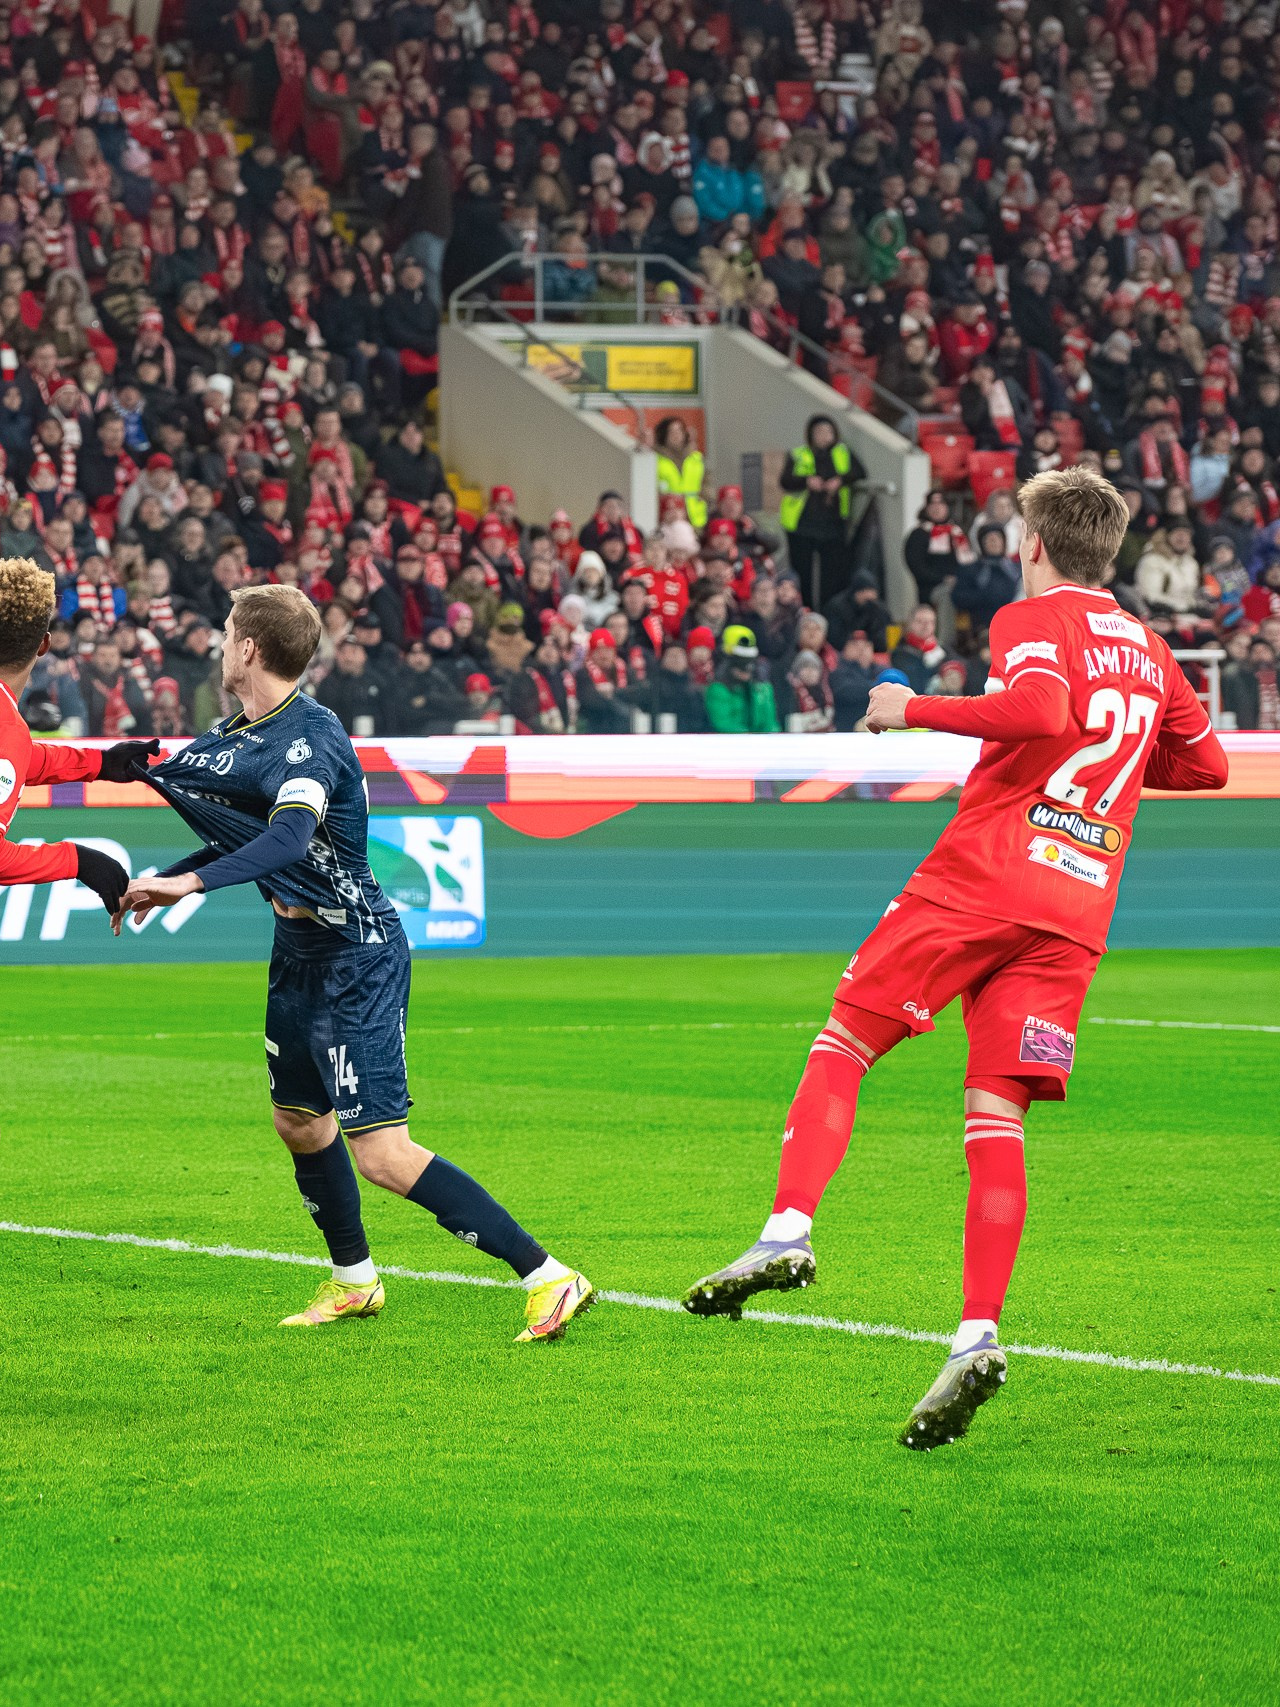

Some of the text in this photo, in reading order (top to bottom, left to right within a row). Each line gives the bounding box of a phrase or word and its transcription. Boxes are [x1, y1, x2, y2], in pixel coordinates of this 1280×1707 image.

[1083, 646, 1165, 695] ДМИТРИЕВ
[1044, 687, 1159, 818] 27
[1032, 805, 1103, 845] WINLINE
[1060, 858, 1098, 880] Маркет
[1024, 1014, 1075, 1042] ЛУКОЙЛ
[327, 1045, 359, 1097] 74
